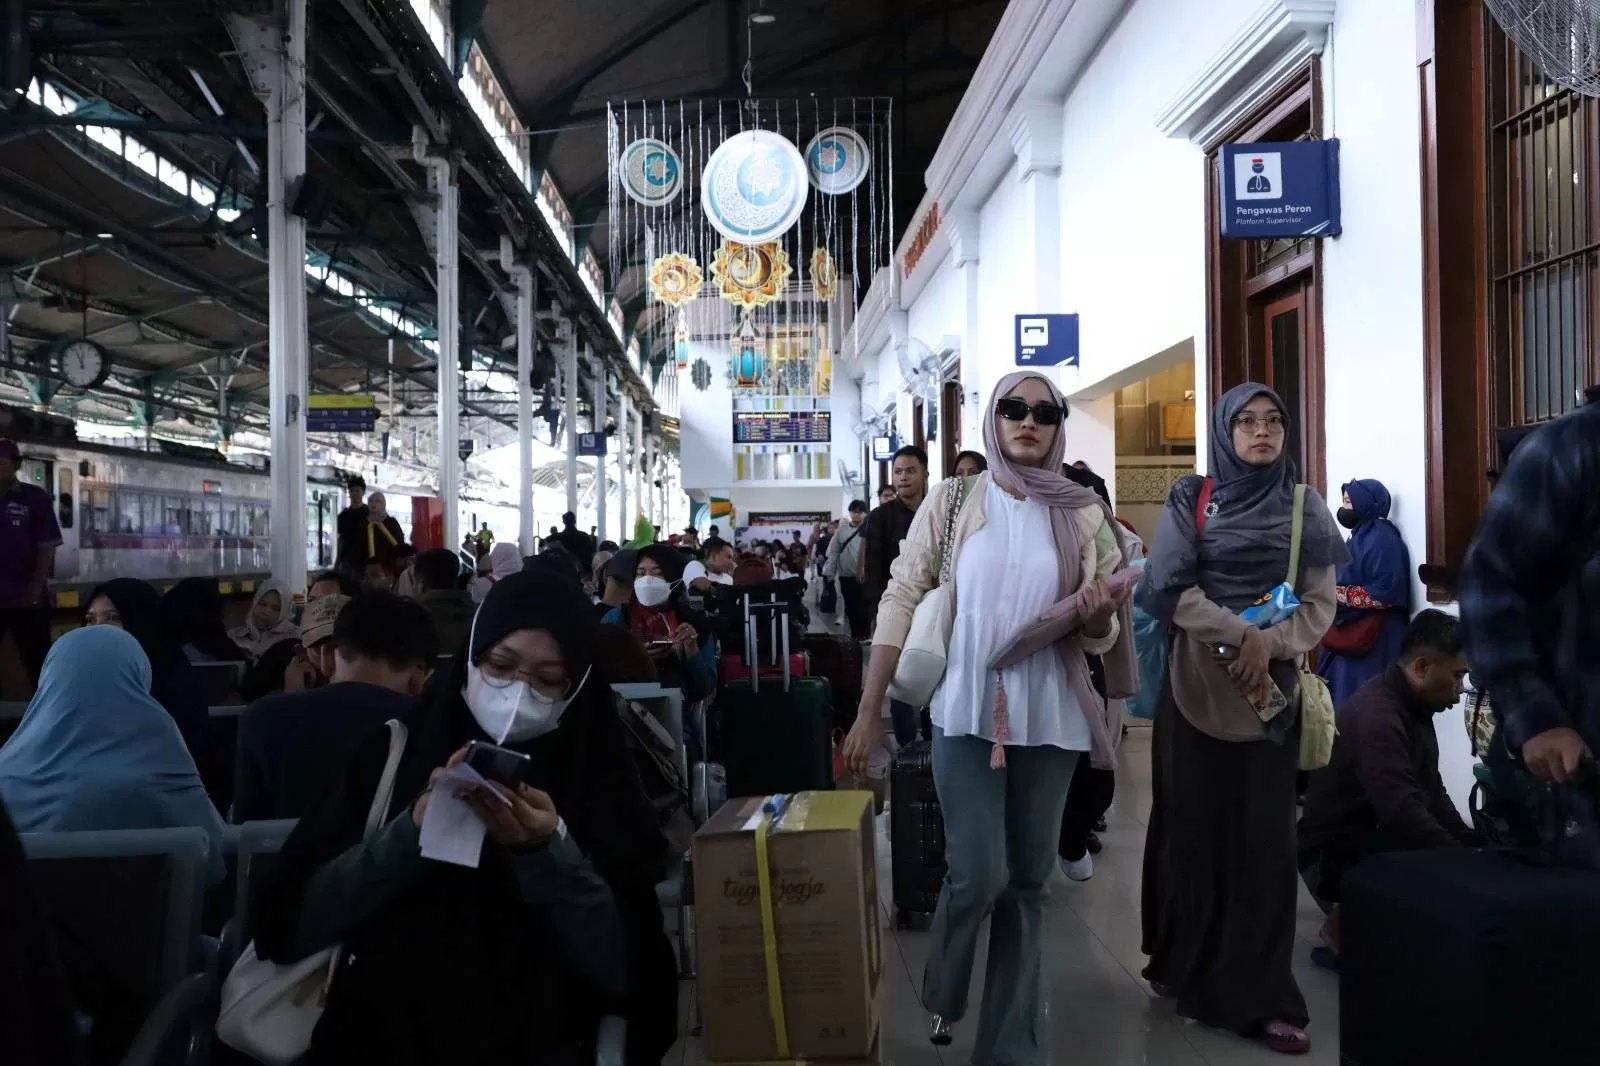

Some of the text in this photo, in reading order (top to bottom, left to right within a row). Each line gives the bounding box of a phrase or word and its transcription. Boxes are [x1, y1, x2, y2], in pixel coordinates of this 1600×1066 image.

[1236, 205, 1312, 216] Pengawas Peron
[1266, 216, 1302, 224] Supervisor
[723, 877, 760, 906] tug
